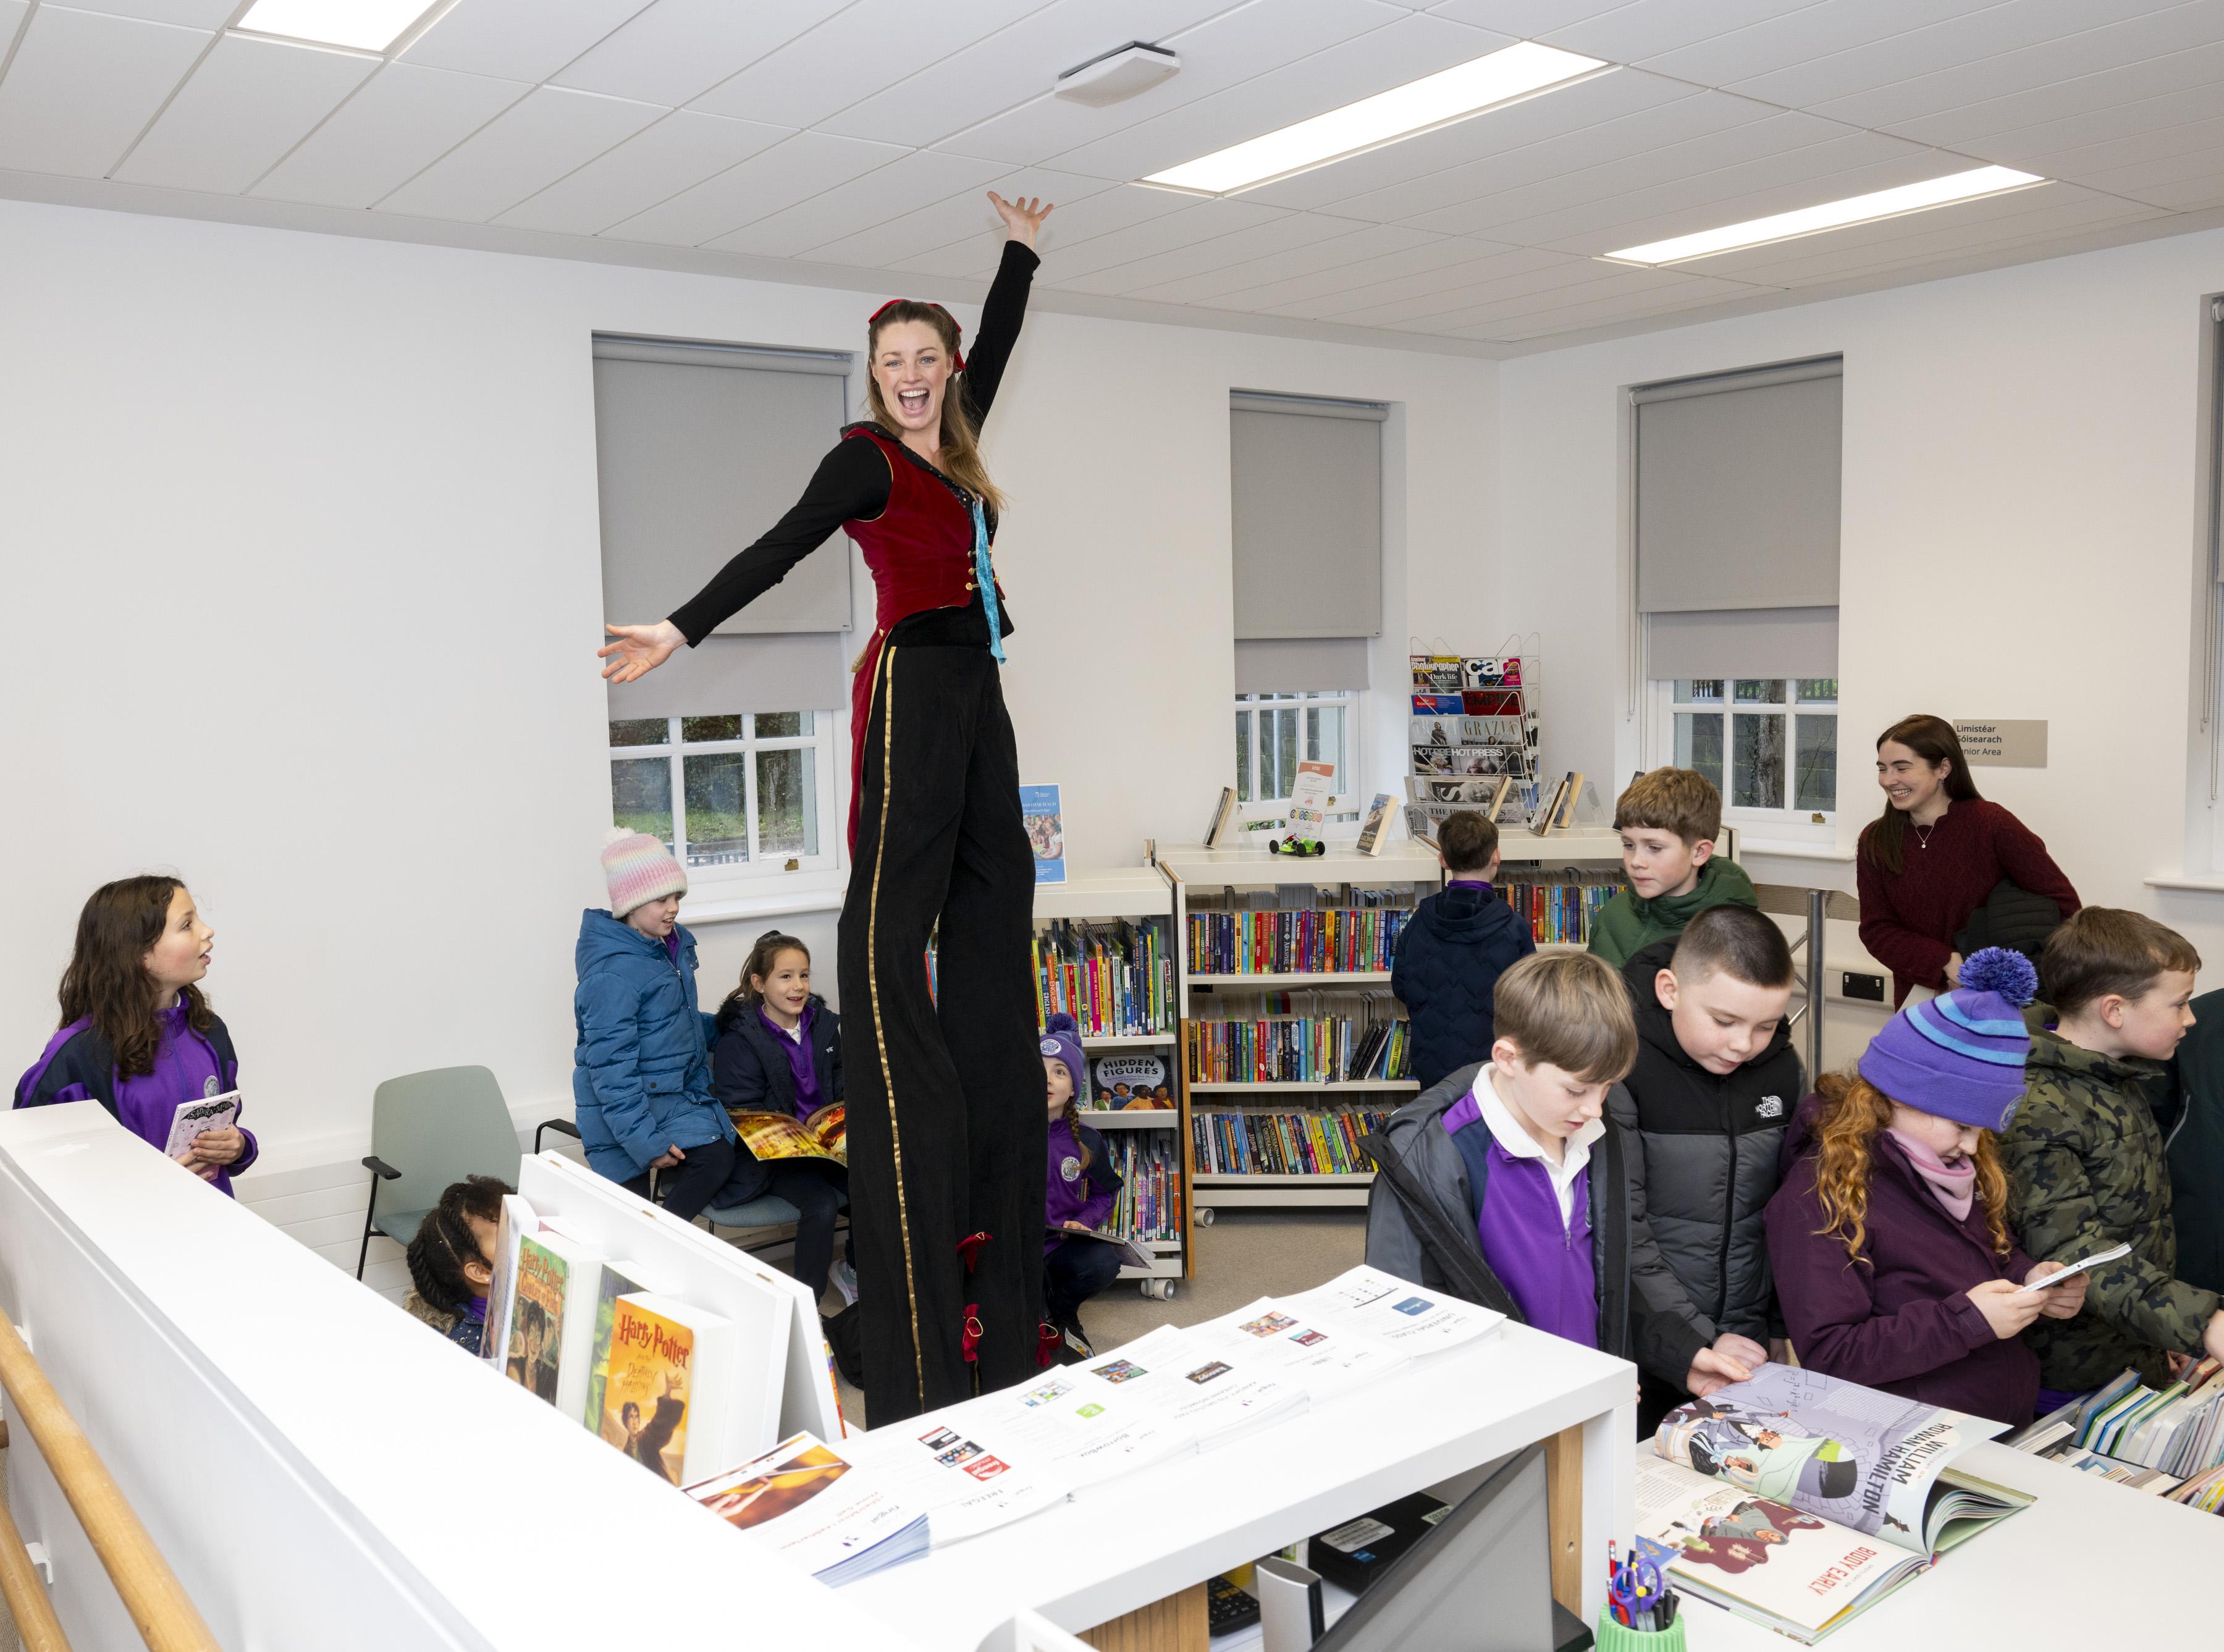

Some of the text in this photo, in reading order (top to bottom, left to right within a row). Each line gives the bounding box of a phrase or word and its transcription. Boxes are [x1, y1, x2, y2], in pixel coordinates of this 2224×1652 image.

[1465, 659, 1509, 676] car
[1464, 720, 1515, 735] GRAZIA
[1957, 725, 1996, 733] Limistéar
[1413, 748, 1433, 756] HOT
[1452, 748, 1504, 757] HOT PRESS
[1982, 748, 2002, 756] Area
[1043, 992, 1051, 1017] ENGLISH
[1392, 1039, 1401, 1057] ETERNITY
[1103, 1059, 1155, 1069] HIDDEN
[1103, 1067, 1158, 1077] FIGURES
[187, 1101, 232, 1119] ISADORA MOON
[1755, 1103, 1775, 1113] NORTH
[1761, 1110, 1775, 1118] FACE
[1248, 1133, 1258, 1153] SKYBORN
[1270, 1129, 1278, 1147] ONYEKA
[521, 1247, 563, 1294] Harry Potter
[1417, 1313, 1456, 1331] UNIVERSAL
[618, 1314, 689, 1370] Harry Potter
[627, 1362, 657, 1380] DEATHLY
[1198, 1366, 1228, 1381] kanopy
[1902, 1423, 1953, 1446] ROWAN
[1080, 1433, 1130, 1457] BorrowBox
[1891, 1440, 1947, 1485] WILLIAM
[1926, 1449, 1950, 1469] SPOTLIGHT
[1862, 1446, 1910, 1515] HAMILTON
[961, 1490, 1003, 1507] FREEGAL
[870, 1505, 900, 1524] fingal
[1808, 1546, 1878, 1596] BIDDY EARLY
